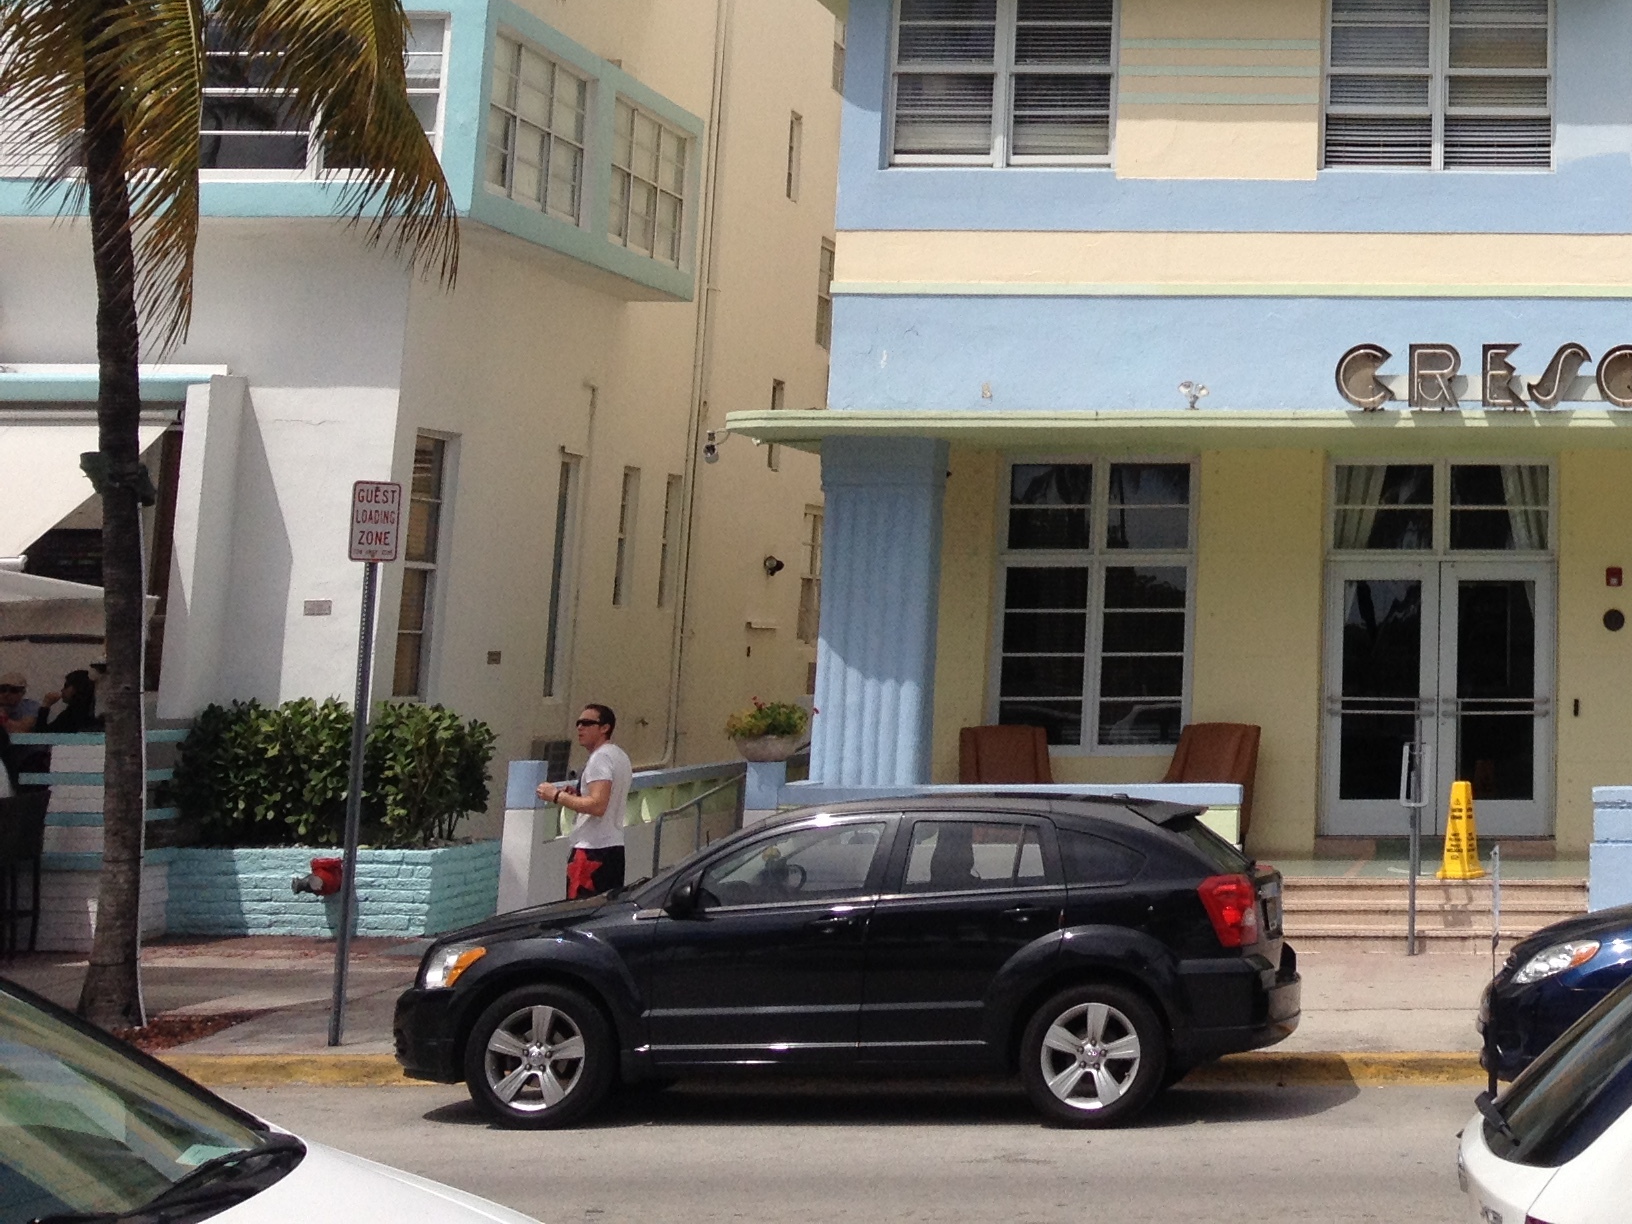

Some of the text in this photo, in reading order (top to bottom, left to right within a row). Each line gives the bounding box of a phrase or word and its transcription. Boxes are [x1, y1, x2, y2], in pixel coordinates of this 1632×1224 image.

[357, 488, 397, 504] GUEST
[355, 509, 396, 524] LOADING
[357, 530, 391, 545] ZONE
